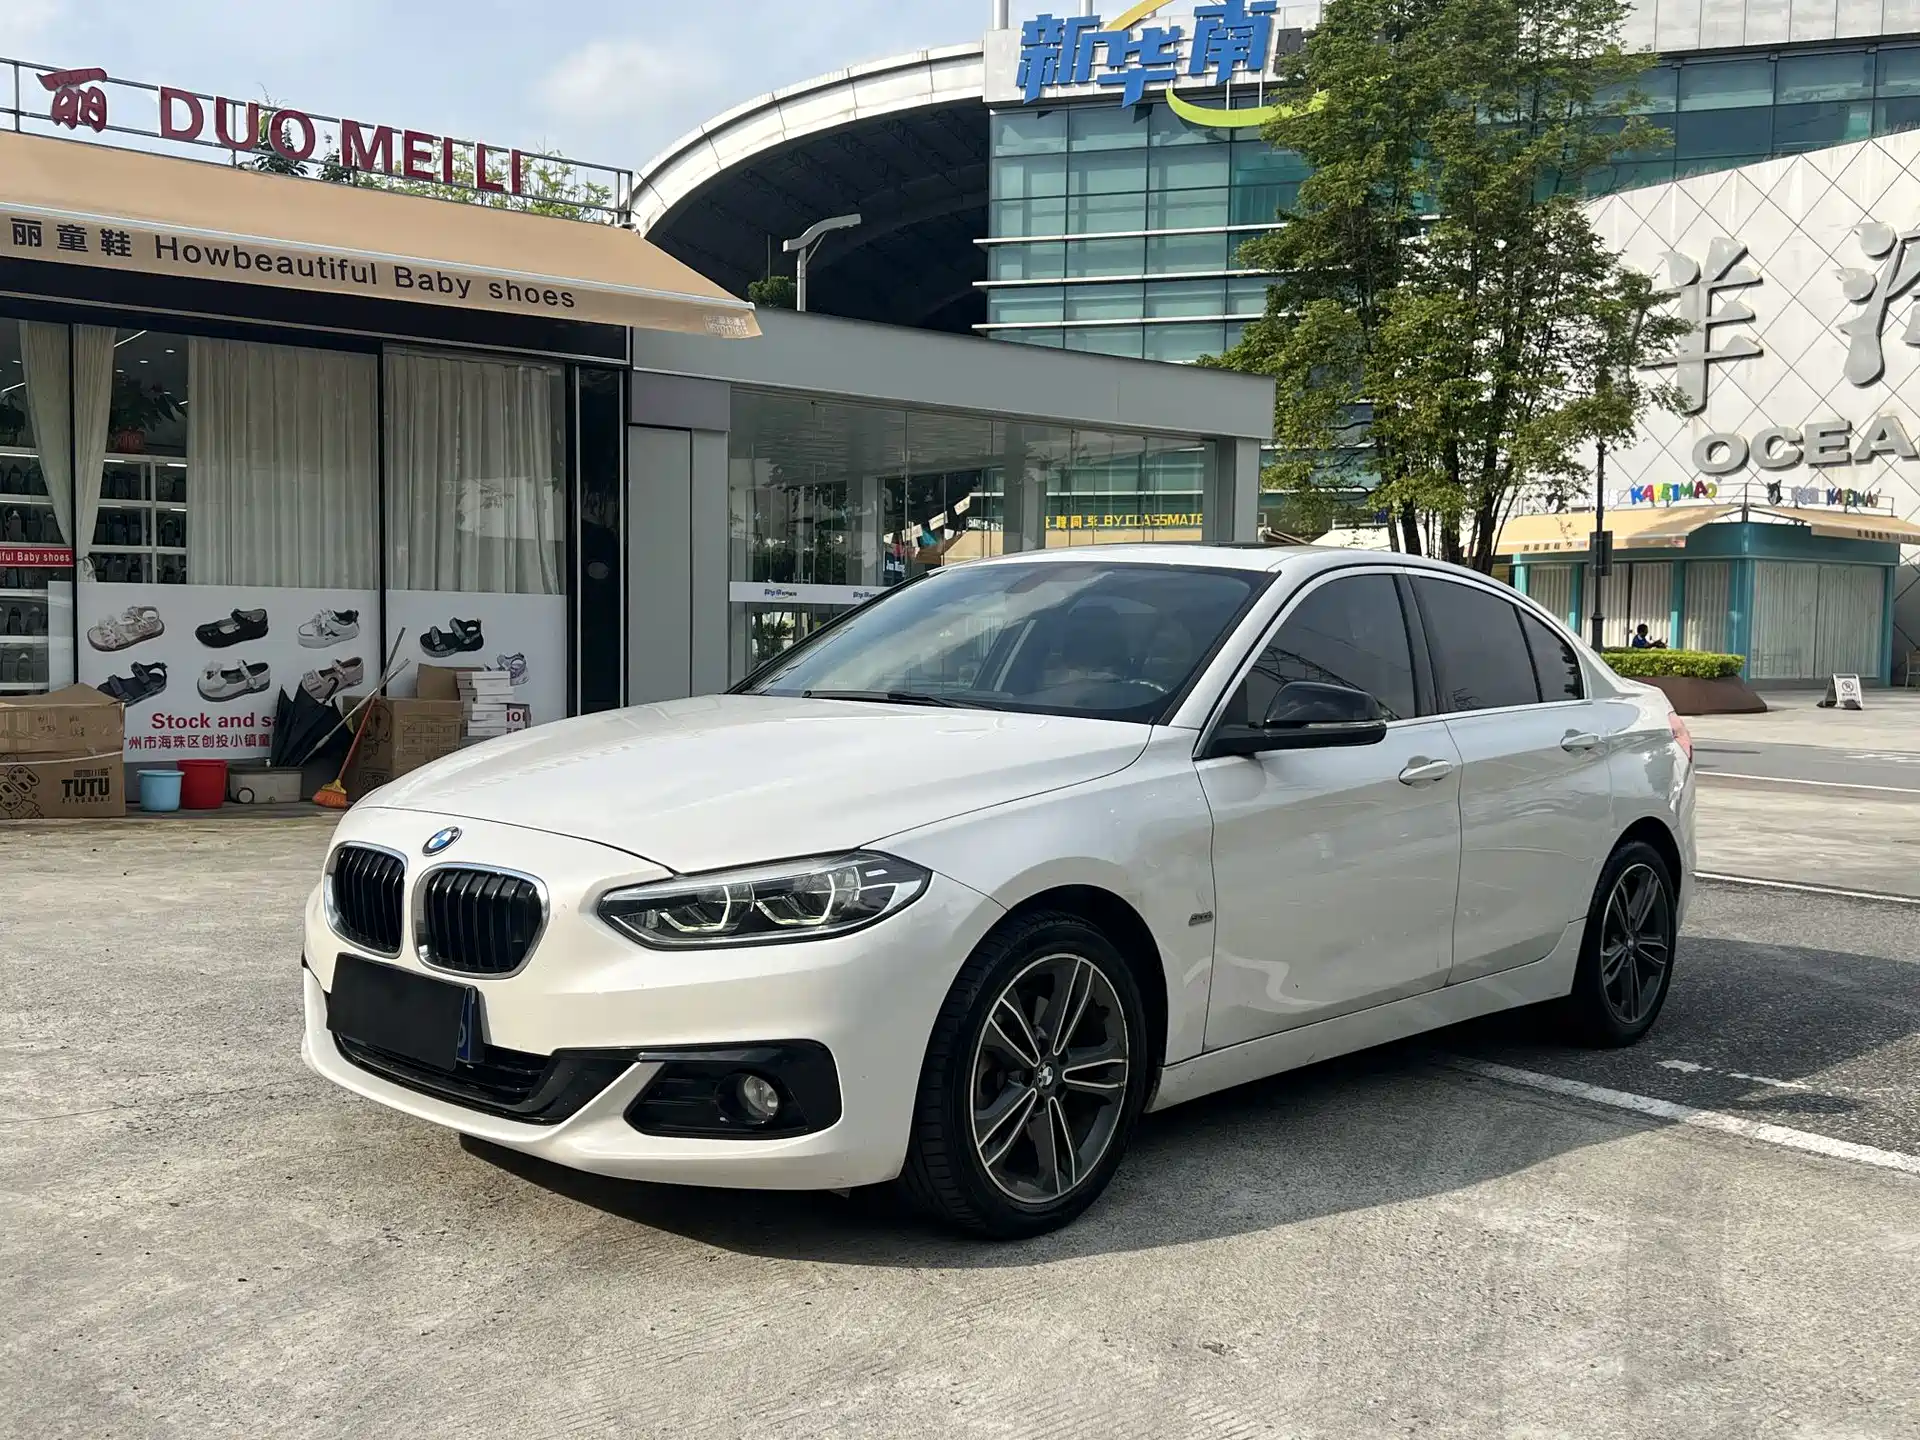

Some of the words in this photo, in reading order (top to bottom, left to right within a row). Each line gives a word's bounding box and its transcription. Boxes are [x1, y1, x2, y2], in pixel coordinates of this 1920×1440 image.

[1015, 0, 1277, 108] 新华南
[36, 67, 107, 133] 丽
[158, 86, 316, 160] DUO
[340, 118, 521, 194] MEILI
[10, 217, 132, 258] 丽童鞋
[155, 234, 377, 285] Howbeautiful
[394, 265, 471, 299] Baby
[488, 280, 575, 308] shoes
[1692, 414, 1920, 474] OCEA
[17, 551, 40, 563] Baby
[43, 552, 70, 562] shoes
[151, 712, 210, 729] Stock
[217, 712, 255, 729] and
[60, 777, 110, 798] TUTU
